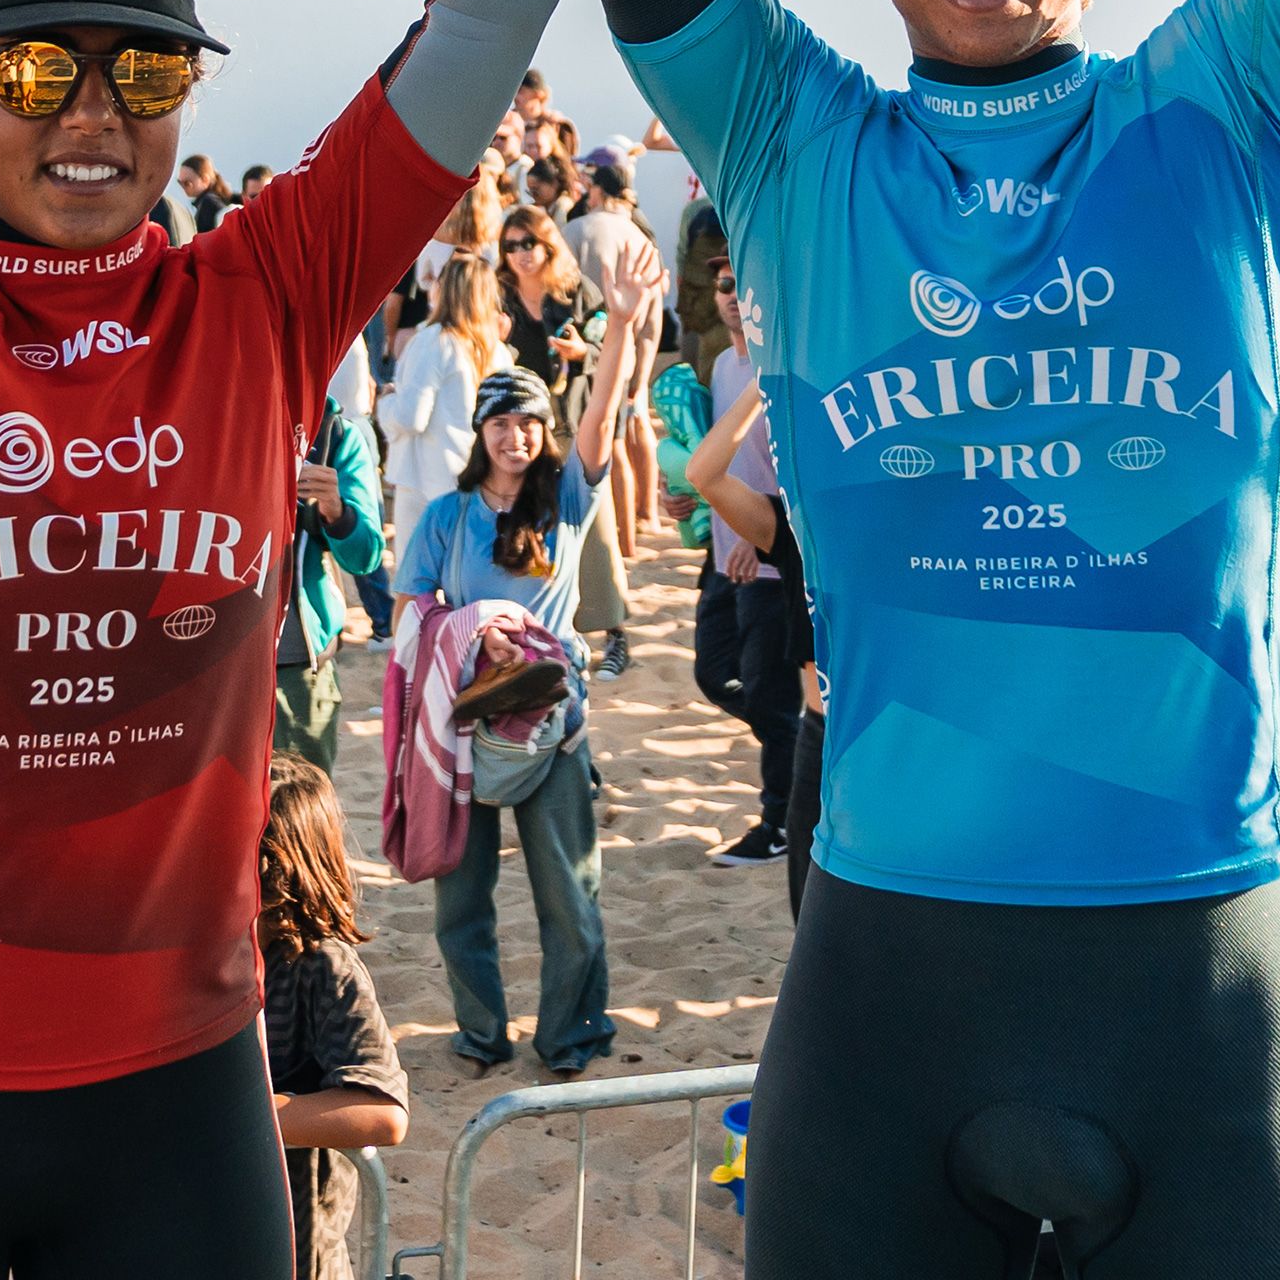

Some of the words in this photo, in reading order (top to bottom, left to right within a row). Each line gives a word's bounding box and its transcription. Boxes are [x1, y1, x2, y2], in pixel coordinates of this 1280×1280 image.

[920, 91, 977, 118] WORLD
[982, 91, 1040, 118] SURF
[985, 178, 1061, 218] WSL
[33, 258, 90, 275] SURF
[992, 255, 1116, 327] edp
[62, 321, 151, 367] WSL
[819, 346, 1239, 454] ERICEIRA
[63, 414, 185, 487] edp
[961, 440, 1082, 481] PRO
[982, 503, 1068, 531] 2025
[910, 555, 968, 573] PRAIA
[975, 555, 1059, 572] RIBEIRA
[979, 574, 1077, 591] ERICEIRA
[14, 608, 138, 653] PRO
[30, 675, 116, 707] 2025
[18, 728, 102, 749] RIBEIRA
[19, 751, 116, 770] ERICEIRA
